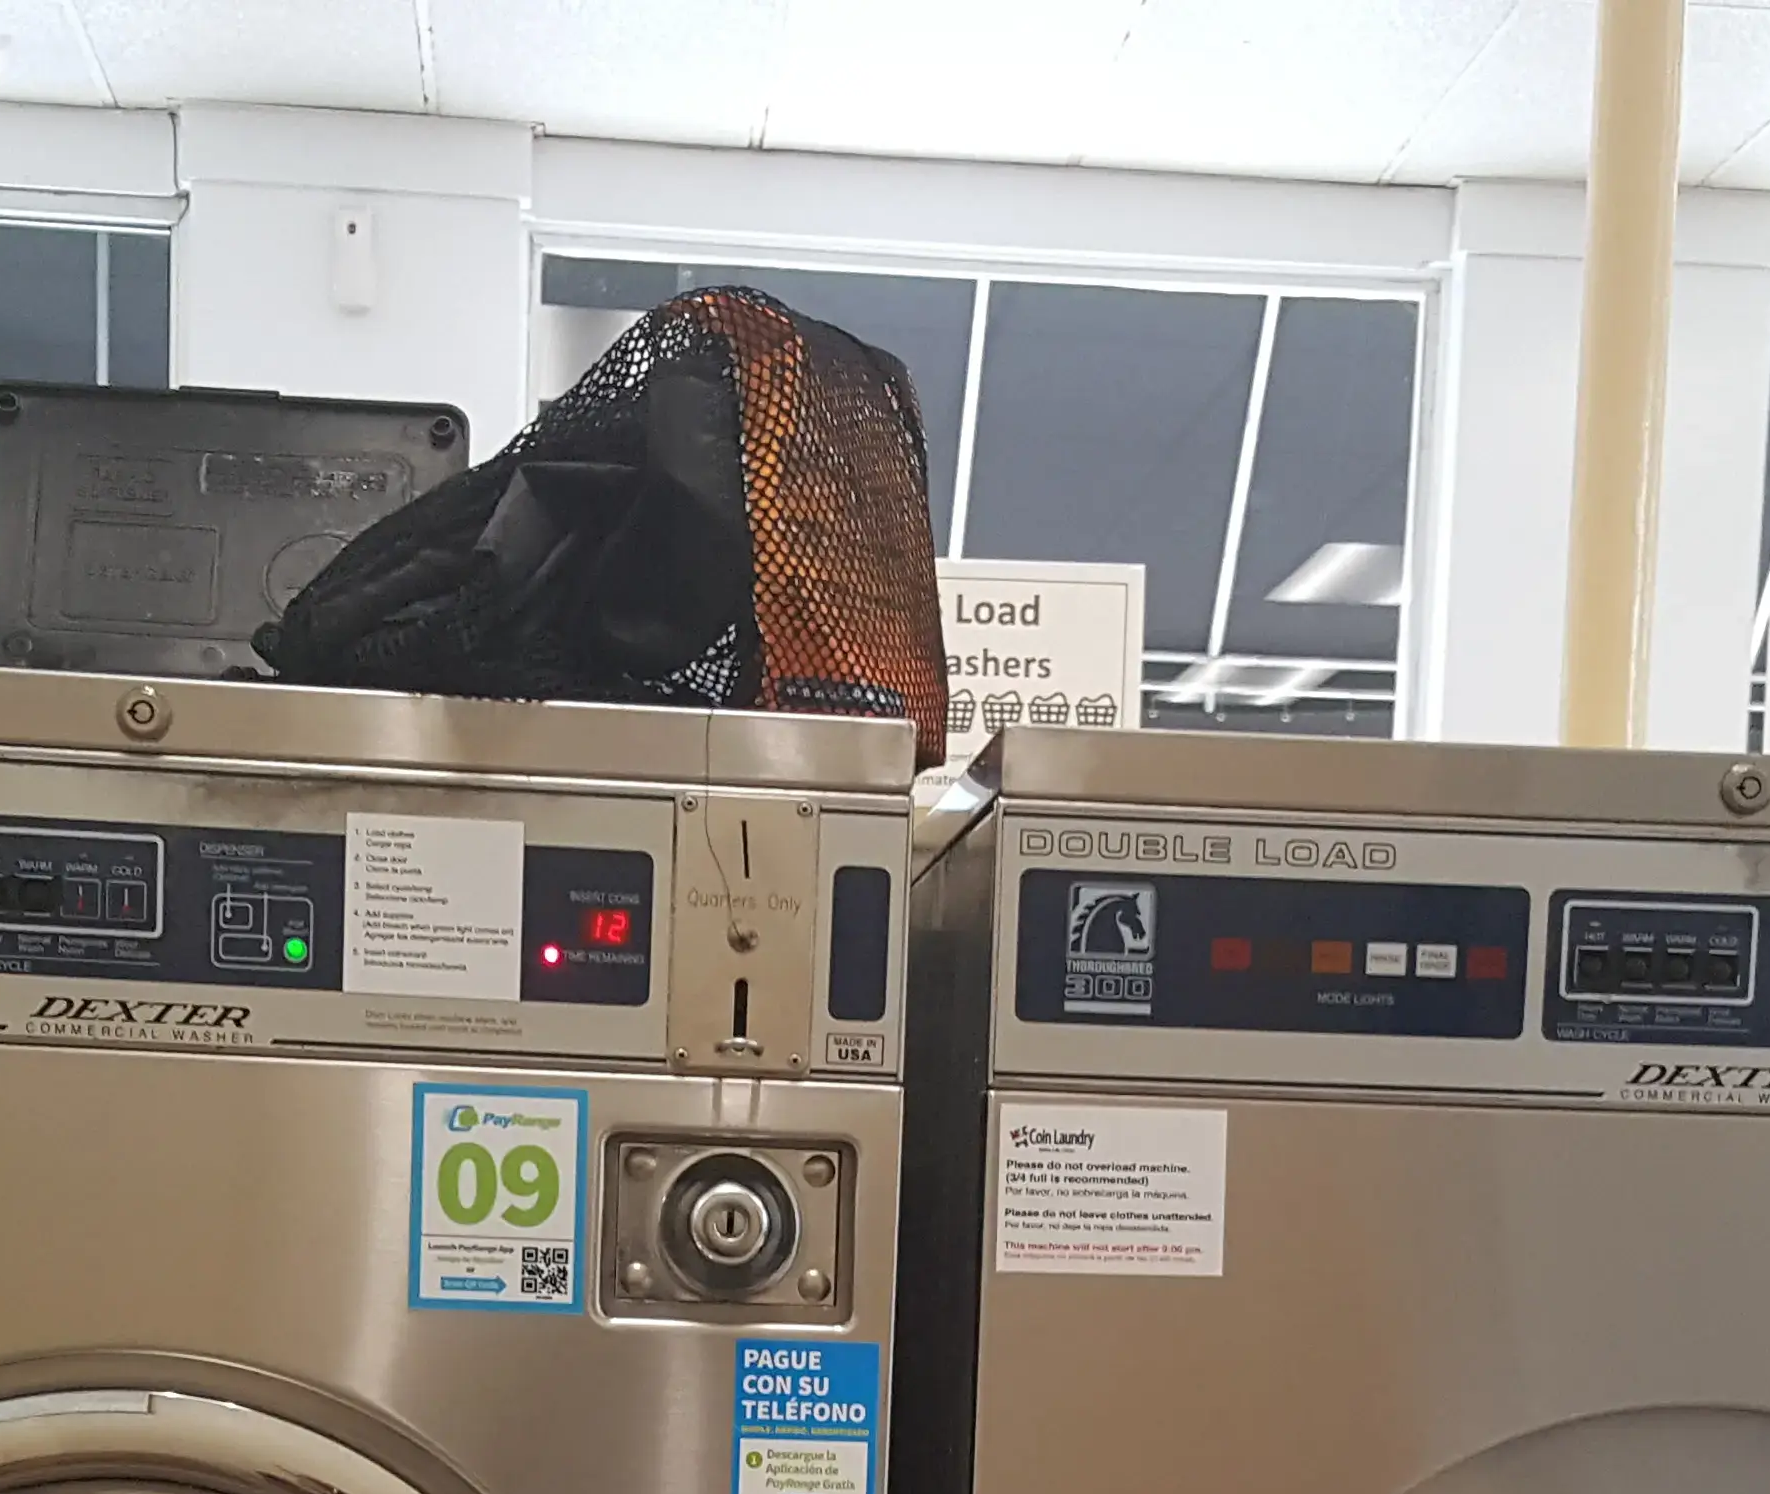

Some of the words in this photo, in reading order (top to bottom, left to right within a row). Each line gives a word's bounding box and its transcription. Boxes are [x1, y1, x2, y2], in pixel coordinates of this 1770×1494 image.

[956, 594, 1040, 626] Load
[946, 649, 1051, 678] ashers
[1019, 828, 1232, 864] DOUBLE
[1254, 838, 1397, 870] LOAD
[687, 888, 756, 912] Quarters
[768, 894, 802, 916] Only
[593, 910, 628, 943] 12
[1066, 960, 1153, 975] THOROUGHBRED
[1064, 975, 1153, 1000] 300
[1317, 991, 1351, 1005] MODE
[1353, 993, 1394, 1006] LIGHTS
[32, 996, 252, 1029] DEXTER
[25, 1021, 159, 1041] COMMERCIAL
[172, 1029, 254, 1044] WASHER
[833, 1037, 863, 1048] MADE
[867, 1039, 877, 1049] IN
[837, 1048, 872, 1063] USA
[1620, 1089, 1743, 1103] COMMERCIAL
[483, 1113, 561, 1130] PayRange
[1029, 1128, 1051, 1145] Coin
[1054, 1129, 1095, 1149] Laundry
[1007, 1159, 1043, 1169] Please
[1046, 1161, 1061, 1170] do
[1064, 1161, 1083, 1171] not
[1086, 1162, 1136, 1172] overload
[1139, 1164, 1190, 1173] machine.
[437, 1142, 560, 1228] 09
[1006, 1173, 1026, 1183] (3/4
[1029, 1174, 1047, 1183] full
[1050, 1174, 1060, 1183] is
[1063, 1175, 1149, 1186] recommended)
[743, 1348, 822, 1370] PAGUE
[743, 1375, 792, 1396] CON
[798, 1376, 829, 1397] SU
[741, 1398, 866, 1423] TELÉFONO
[767, 1449, 824, 1463] Descargue
[826, 1451, 837, 1461] la
[765, 1463, 821, 1476] Aplicación
[824, 1464, 839, 1476] de
[765, 1478, 821, 1491] PayRange
[823, 1479, 855, 1491] Gratis
